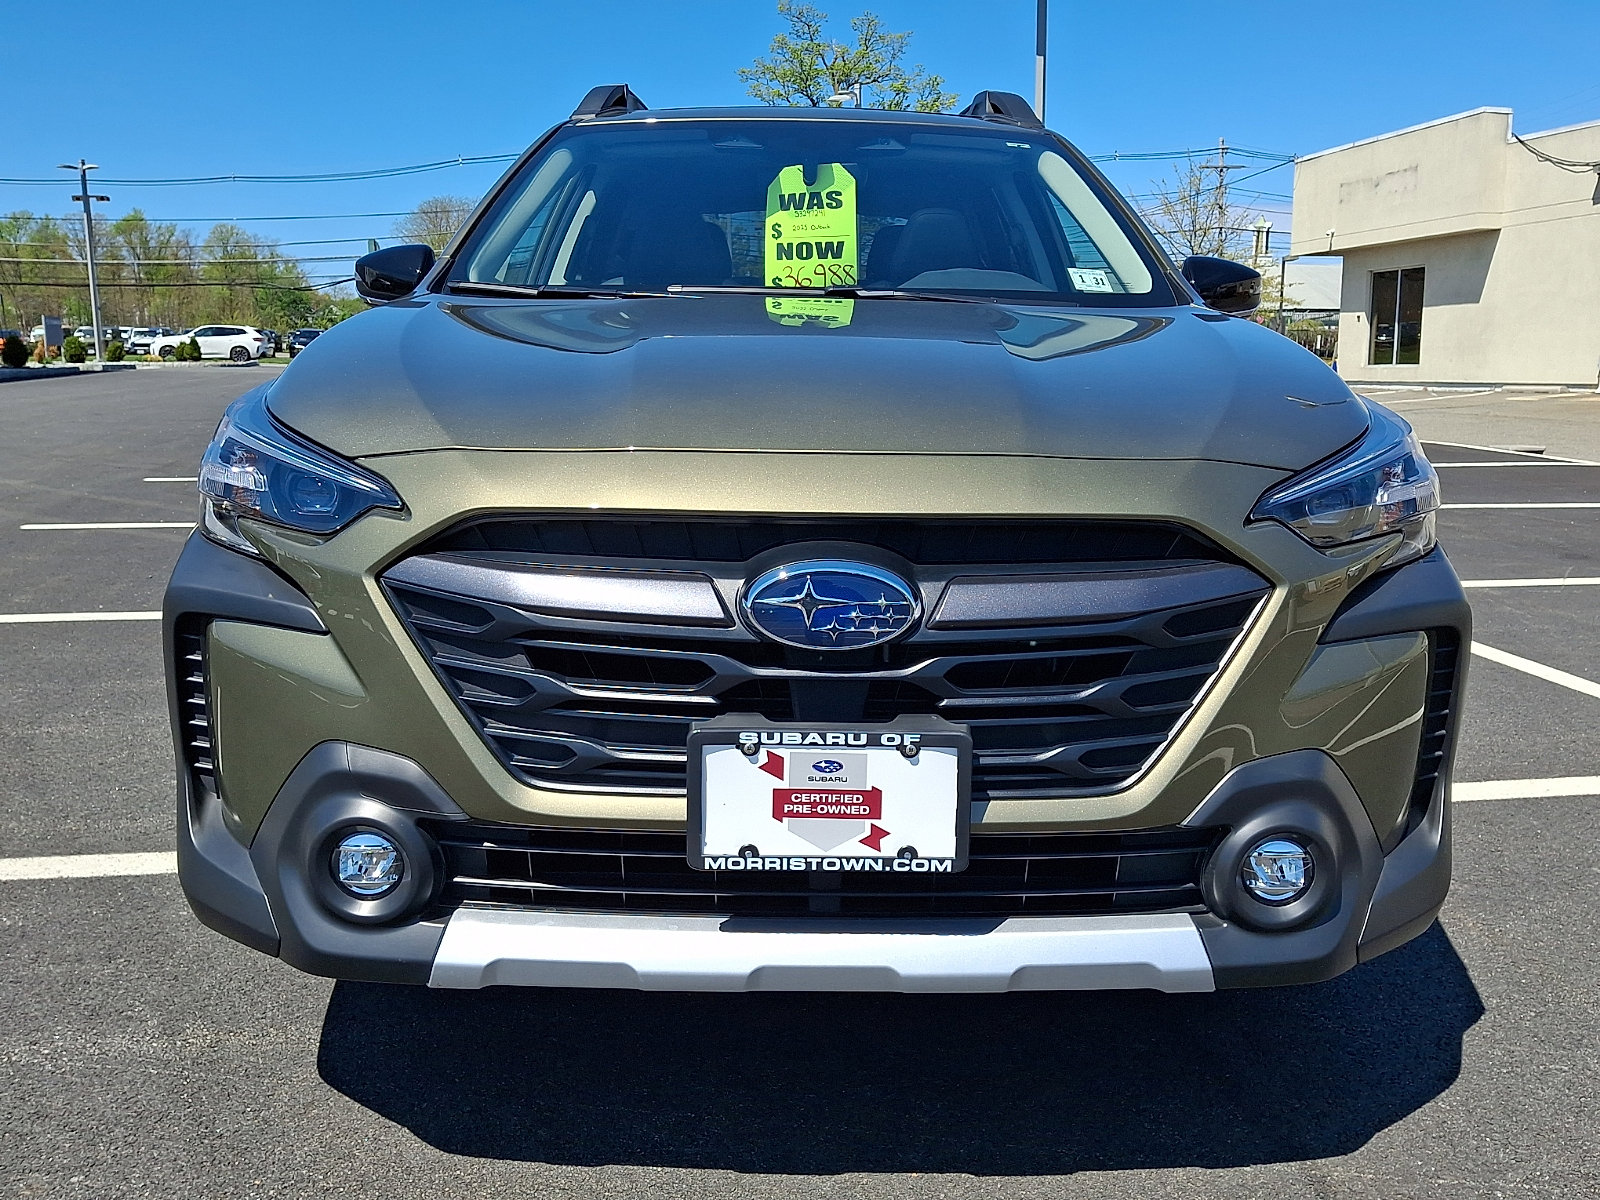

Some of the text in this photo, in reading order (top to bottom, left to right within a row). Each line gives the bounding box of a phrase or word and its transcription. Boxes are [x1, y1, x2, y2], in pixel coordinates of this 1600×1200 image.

[778, 190, 843, 212] WAS
[771, 222, 783, 240] $
[776, 241, 845, 261] NOW
[738, 731, 921, 746] SUBARU OF
[807, 775, 848, 783] SUBARU
[790, 793, 864, 804] CERTIFIED
[783, 804, 870, 815] PRE-OWNED
[703, 857, 953, 873] MORRISTOWN.COM
